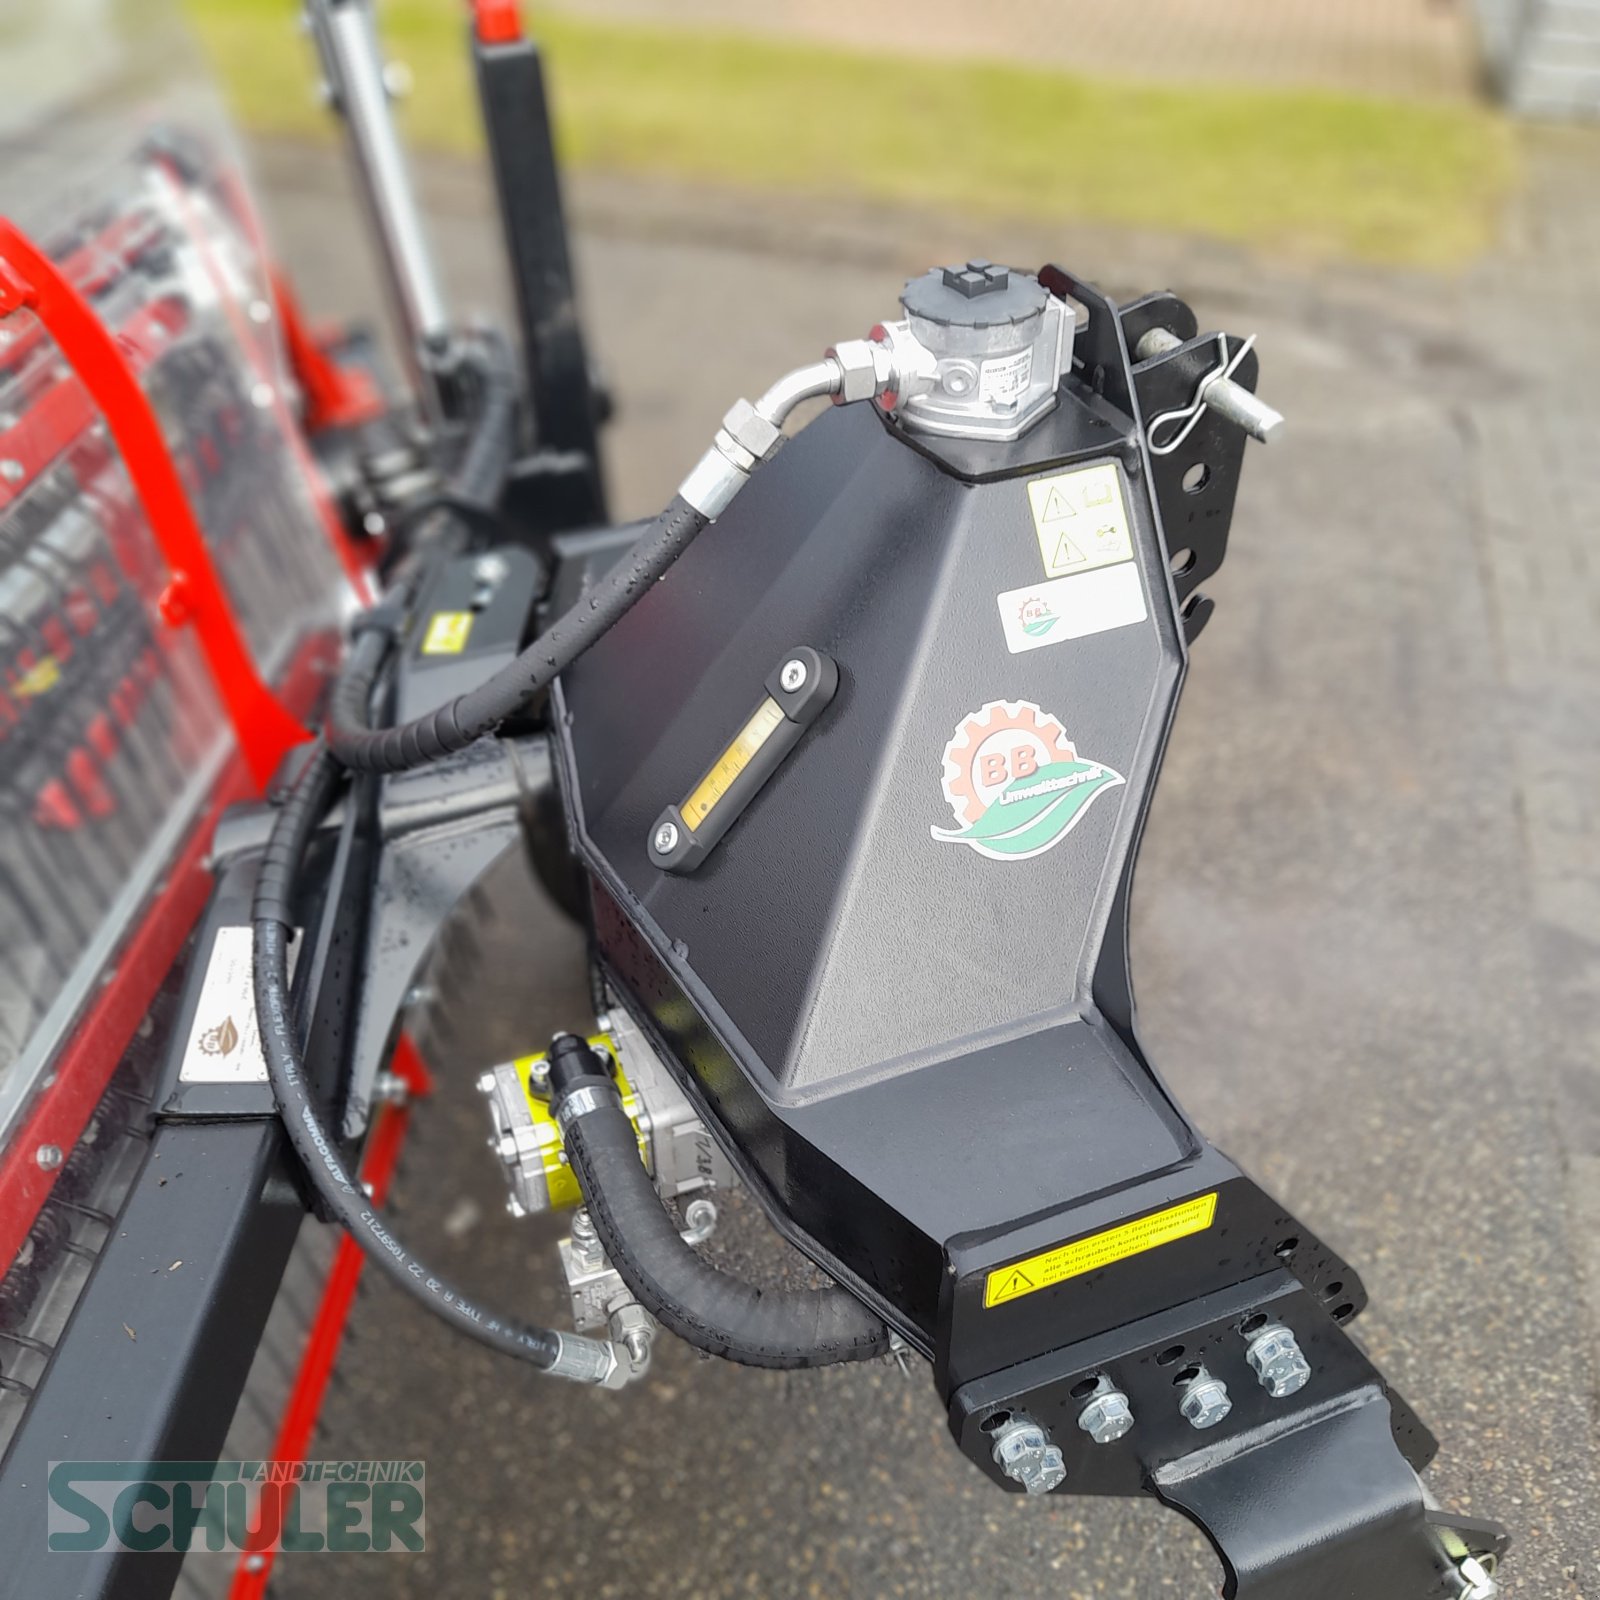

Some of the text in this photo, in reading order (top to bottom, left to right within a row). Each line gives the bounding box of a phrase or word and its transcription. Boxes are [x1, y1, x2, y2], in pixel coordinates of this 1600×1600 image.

[980, 745, 1039, 787] BB
[280, 1053, 299, 1087] ITALY
[408, 1262, 424, 1278] 22
[455, 1300, 482, 1323] TYPE
